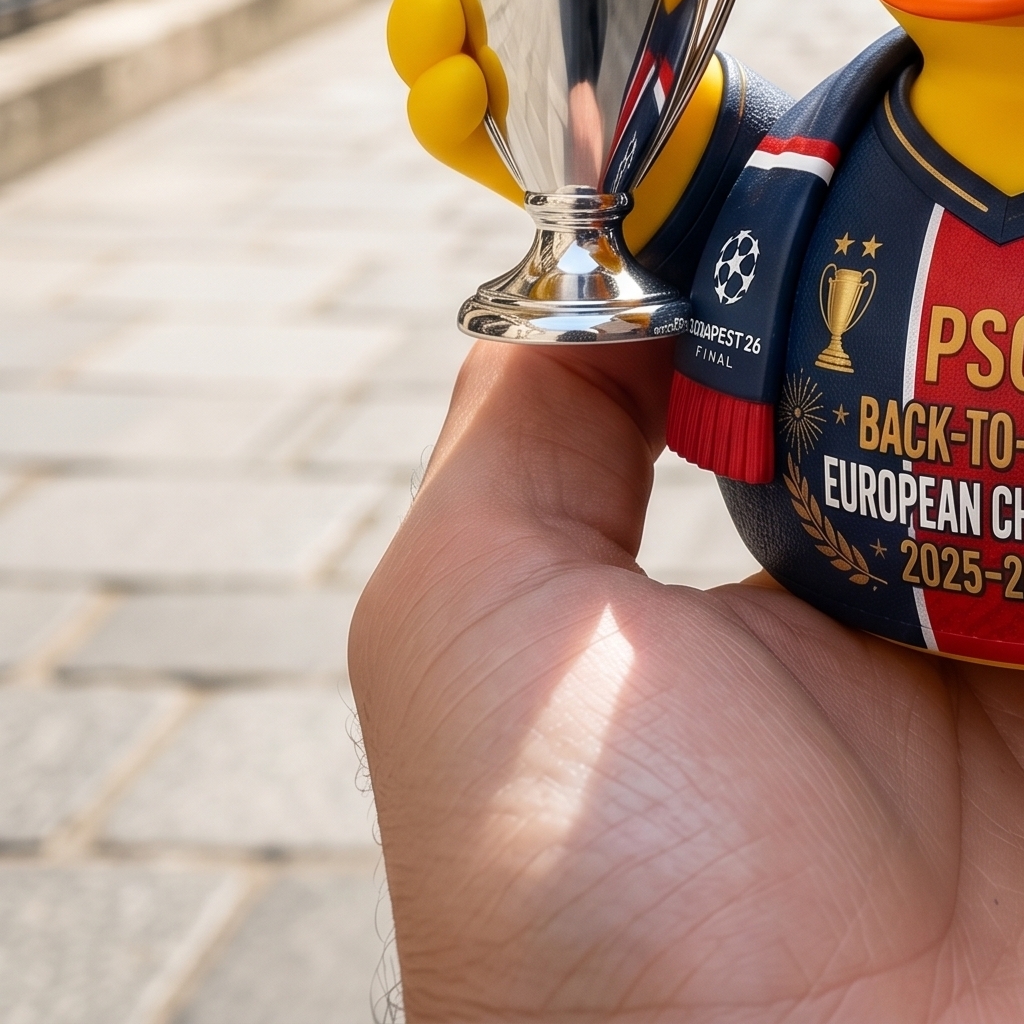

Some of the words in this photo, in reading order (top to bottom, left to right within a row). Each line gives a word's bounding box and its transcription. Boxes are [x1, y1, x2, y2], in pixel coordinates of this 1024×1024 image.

[743, 334, 761, 355] 26
[695, 345, 733, 369] FINAL
[823, 455, 981, 536] EUROPEAN
